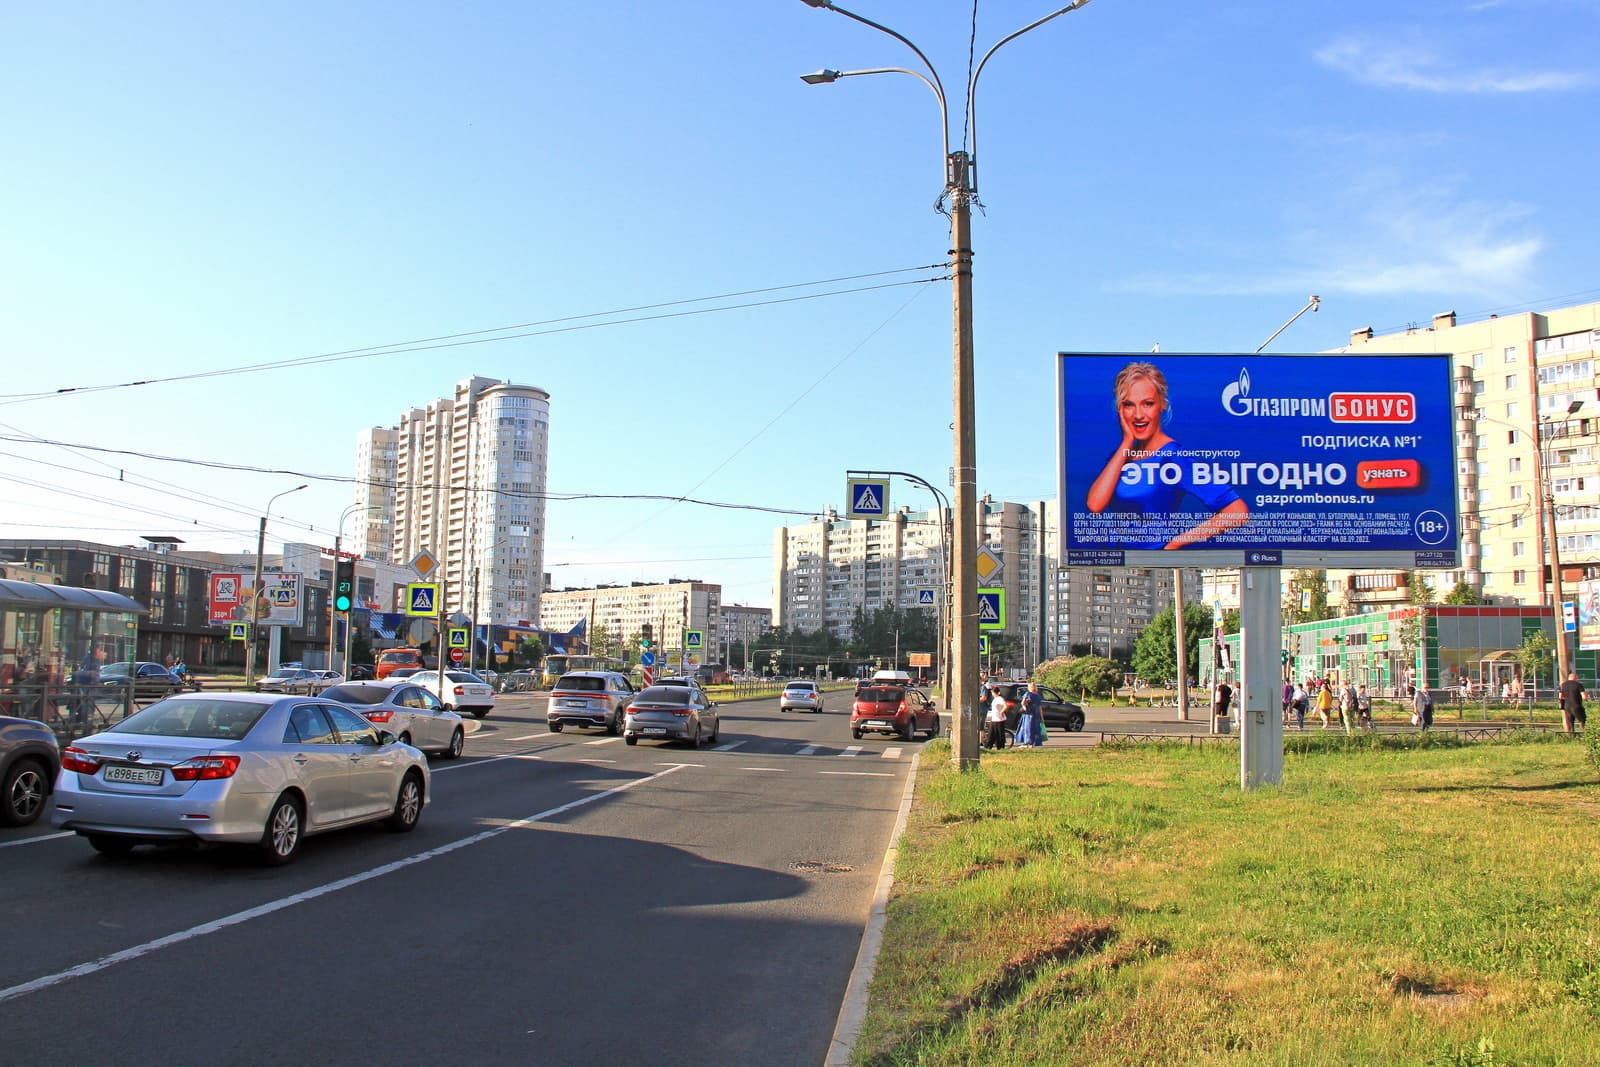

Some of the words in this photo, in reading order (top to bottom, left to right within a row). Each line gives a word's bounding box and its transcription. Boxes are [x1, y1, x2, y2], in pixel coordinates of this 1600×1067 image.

[1253, 398, 1325, 417] ГАЗПРОМ
[1335, 399, 1409, 417] БОНУС
[1301, 435, 1390, 450] ПОДПИСКА
[1122, 448, 1240, 459] Подписка-конструктор
[1121, 462, 1183, 485] ЭТО
[1192, 462, 1347, 489] ВЫГОДНО
[1363, 468, 1408, 481] узнать
[1256, 493, 1375, 507] gazprombonus.ru
[1419, 521, 1444, 533] 18+
[340, 582, 351, 592] 27
[146, 770, 160, 780] 178
